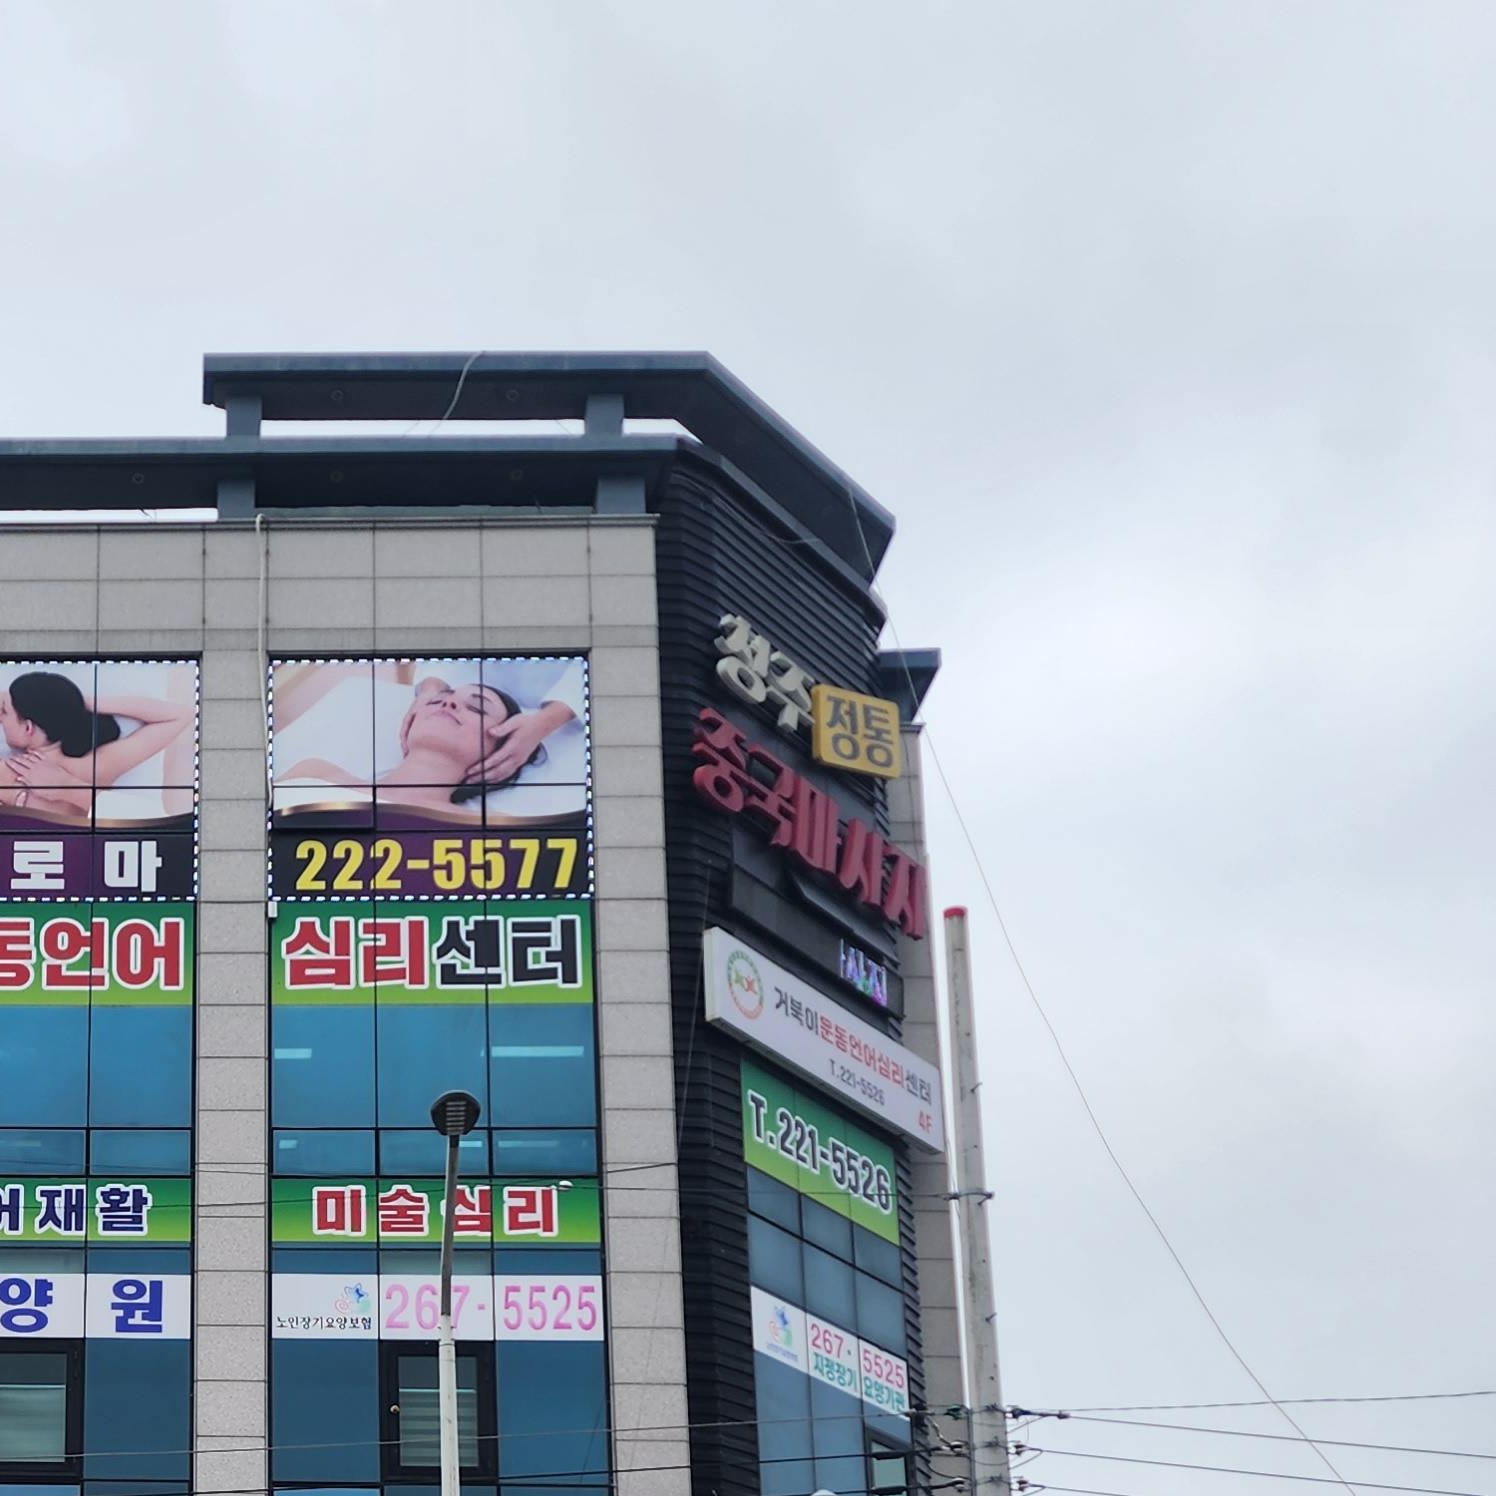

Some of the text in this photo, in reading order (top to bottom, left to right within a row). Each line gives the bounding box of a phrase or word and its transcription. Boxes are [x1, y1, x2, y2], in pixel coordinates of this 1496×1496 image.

[713, 613, 817, 733] 청주
[826, 695, 894, 768] 정통
[691, 706, 924, 940] 중국마사지
[295, 838, 578, 891] 222-5577
[281, 914, 582, 990] 심리센터
[747, 1089, 893, 1215] T.221-5526
[311, 1183, 560, 1237] 미술심리
[276, 1315, 373, 1330] 노인장기요양보험
